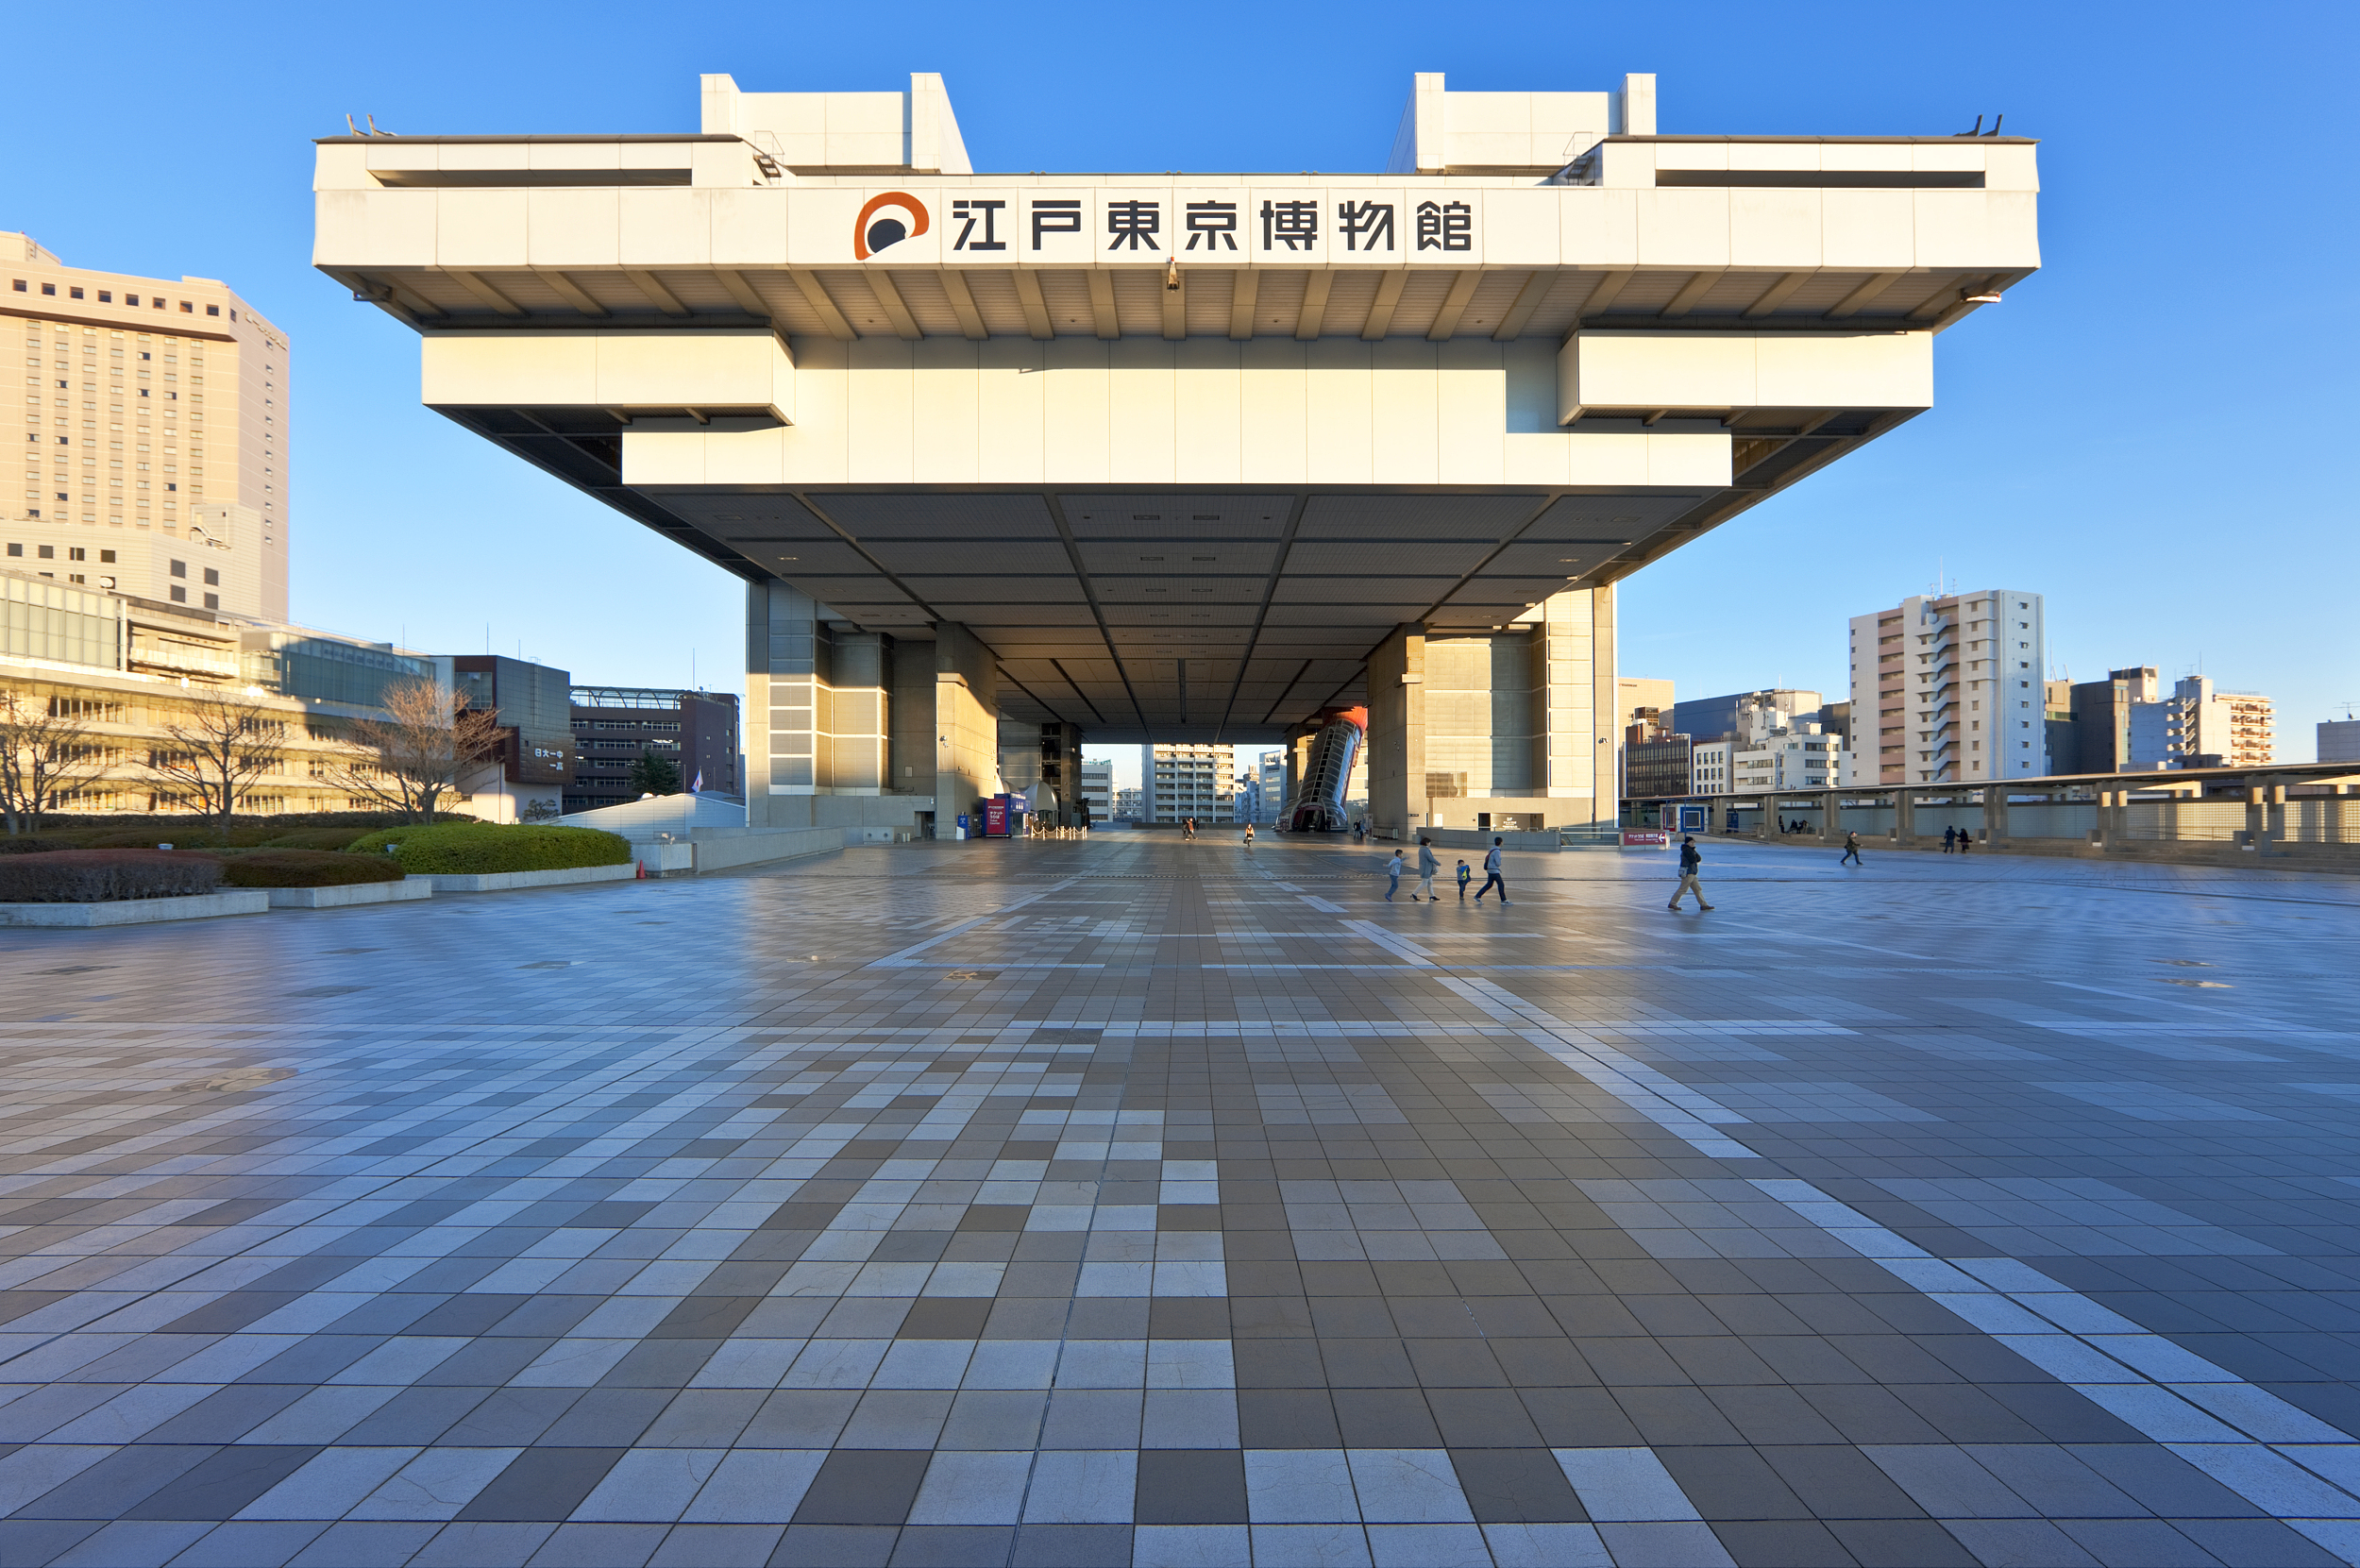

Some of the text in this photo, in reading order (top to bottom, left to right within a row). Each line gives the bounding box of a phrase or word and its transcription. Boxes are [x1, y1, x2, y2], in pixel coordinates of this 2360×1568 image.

[952, 199, 1472, 251] 江戸東京博物館
[534, 748, 564, 759] 日大一中
[548, 762, 564, 771] 一高
